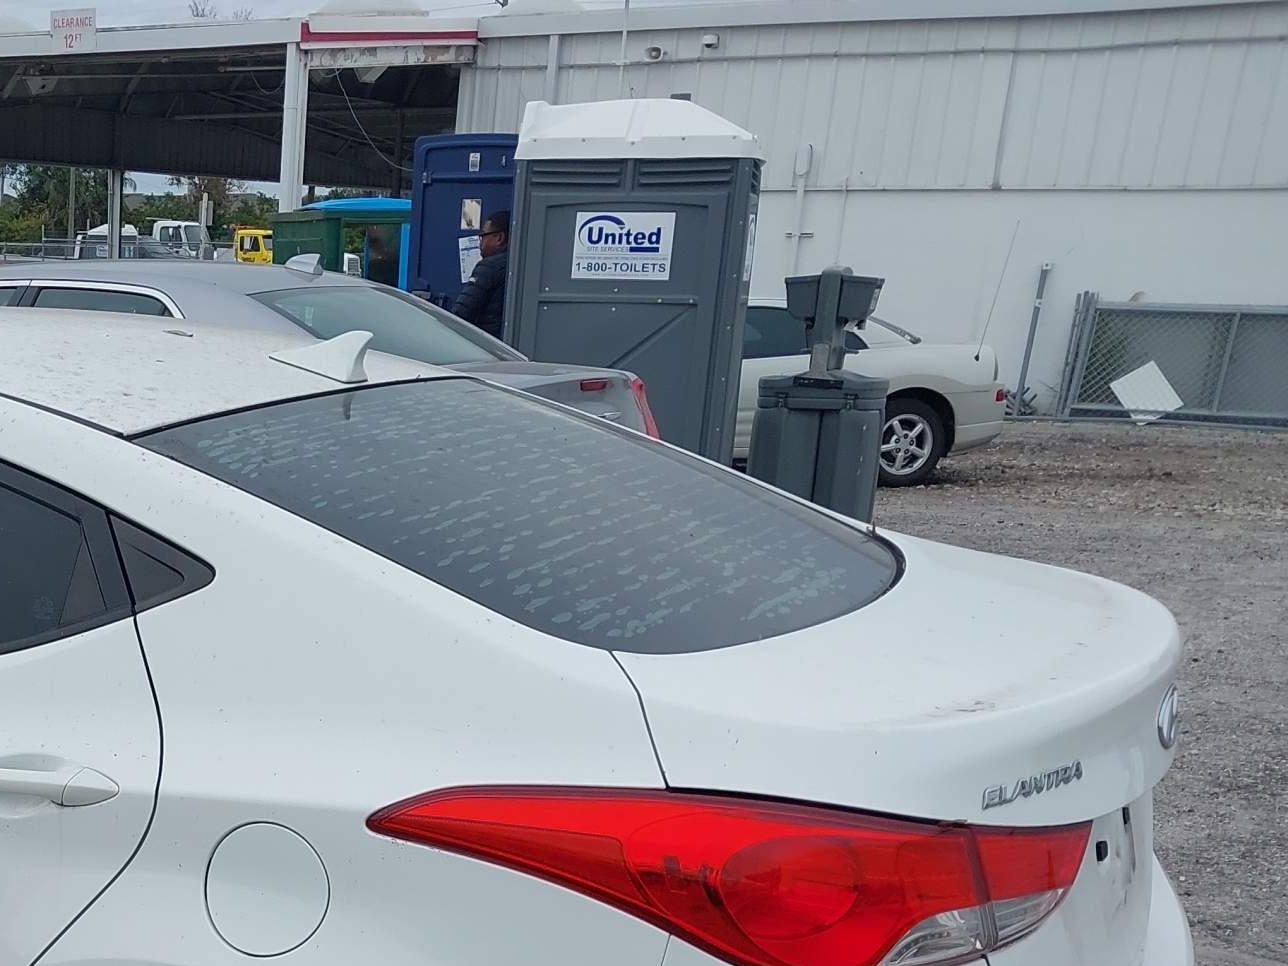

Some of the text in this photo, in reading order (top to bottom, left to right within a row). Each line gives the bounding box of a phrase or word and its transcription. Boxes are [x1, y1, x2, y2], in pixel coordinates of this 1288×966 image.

[53, 16, 93, 29] CLEARANCE
[587, 226, 662, 246] United
[575, 262, 667, 273] 1-800-TOILETS
[981, 759, 1084, 810] ELANTRA
